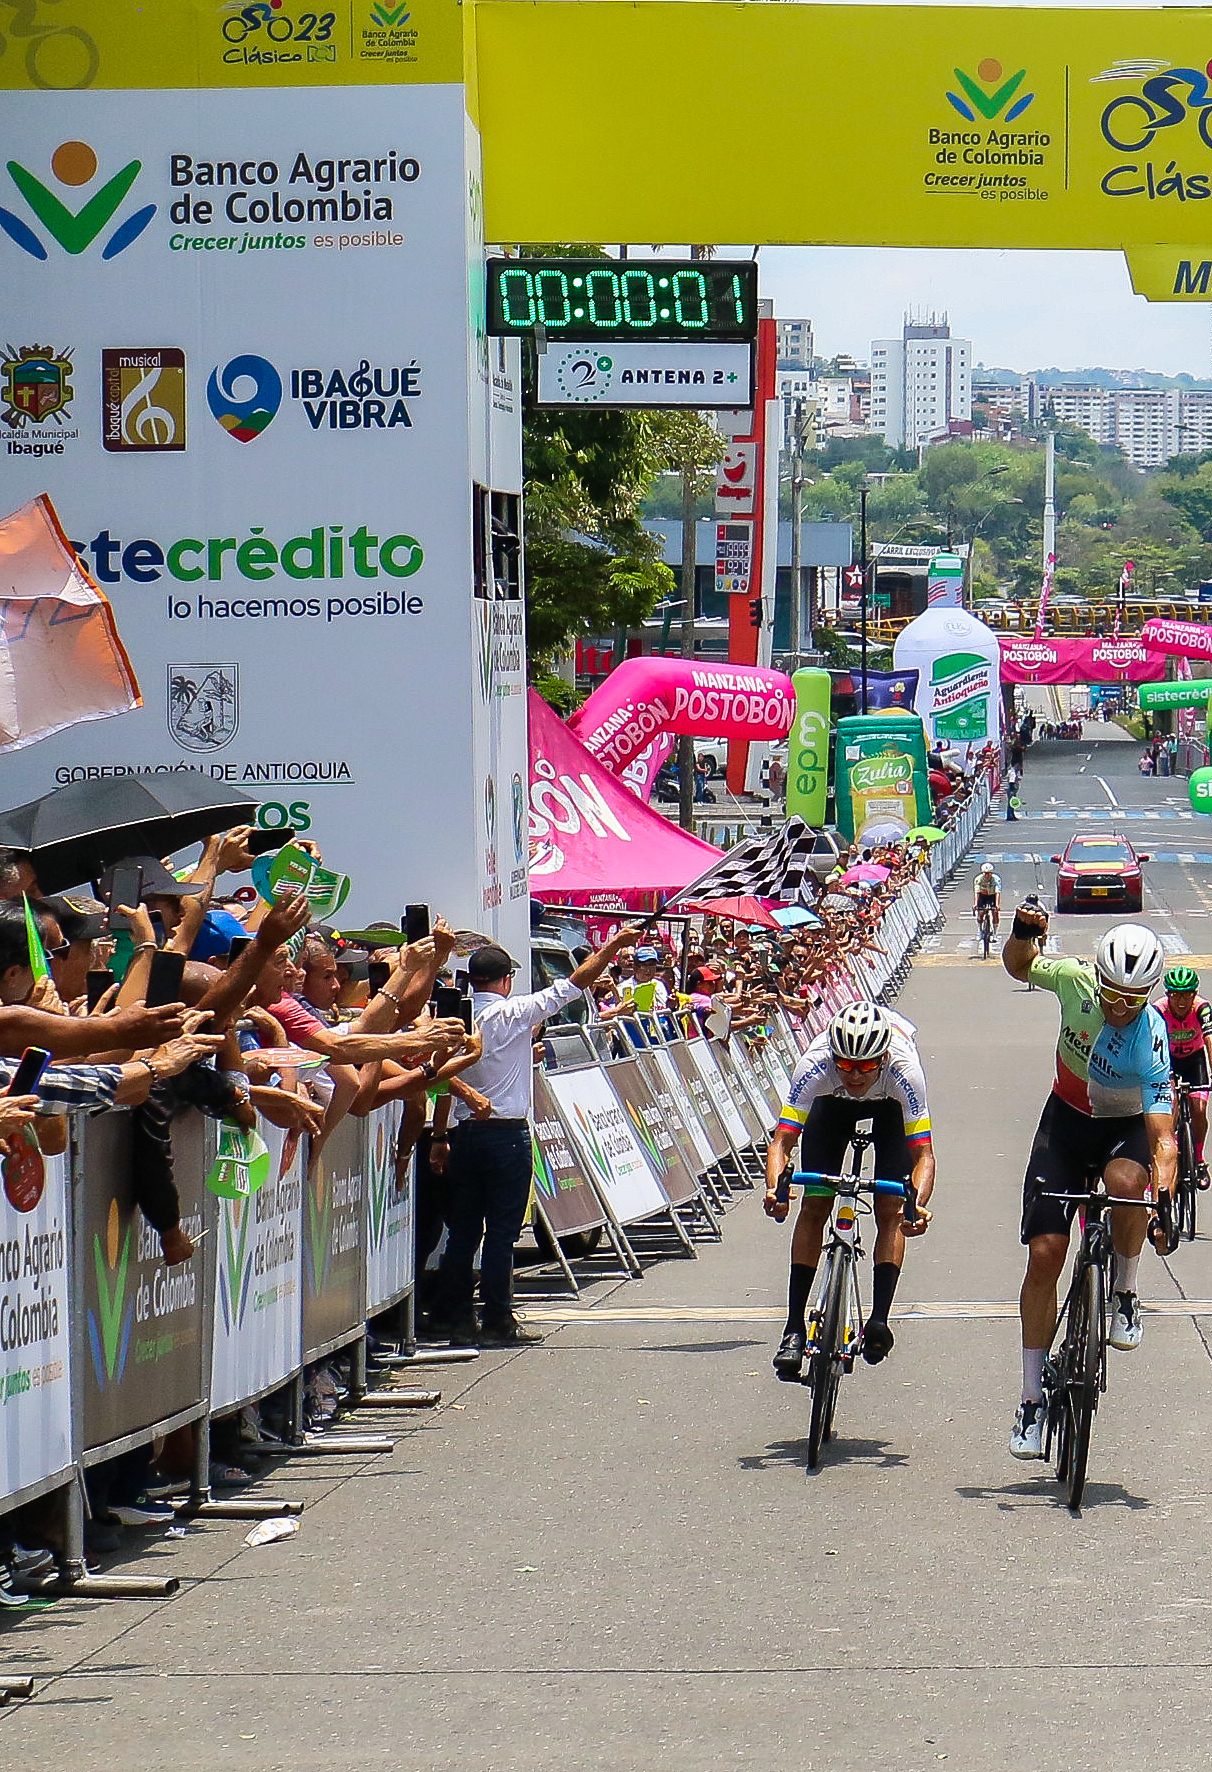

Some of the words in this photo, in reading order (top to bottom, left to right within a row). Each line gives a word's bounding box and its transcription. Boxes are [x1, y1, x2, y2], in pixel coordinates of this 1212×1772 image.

[294, 13, 336, 41] 23
[362, 30, 387, 39] Banco
[389, 30, 418, 41] Agrario
[377, 39, 416, 47] Colombia
[222, 46, 303, 65] Clásico
[929, 129, 982, 147] Banco
[987, 128, 1051, 152] Agrario
[935, 147, 961, 165] de
[963, 146, 1045, 165] Colombia
[170, 154, 279, 187] Banco
[289, 151, 421, 192] Agrario
[923, 173, 974, 188] Crecer
[973, 171, 1027, 191] juntos
[980, 190, 997, 201] es
[999, 187, 1049, 202] posible
[169, 193, 213, 225] de
[226, 190, 393, 224] Colombia
[169, 232, 240, 251] Crecer
[238, 231, 306, 255] juntos
[313, 234, 334, 249] es
[337, 230, 404, 252] posible
[500, 269, 743, 328] 00:00:01
[119, 353, 162, 367] musical
[621, 369, 705, 385] ANTENA
[304, 400, 413, 430] VIBRA
[0, 429, 30, 439] lcaldía
[31, 429, 79, 440] Municipal
[7, 440, 65, 457] Ibagué
[72, 526, 425, 583] stecrédito
[882, 546, 904, 555] CARRIL
[168, 595, 191, 619] lo
[199, 594, 321, 620] hacemos
[327, 591, 424, 623] posible
[691, 670, 768, 693] MANZANA
[933, 670, 988, 698] Aguardiente
[1146, 688, 1212, 704] sistecrédi
[583, 706, 634, 755] ANZANA
[797, 710, 827, 795] epm
[210, 763, 237, 781] DE
[242, 761, 352, 783] ANTIOQUIA
[857, 762, 907, 785] Zulia
[0, 1240, 20, 1281] nco
[23, 1213, 63, 1288] Agrario
[136, 1283, 149, 1323] de
[153, 1264, 196, 1317] Colombia
[0, 1284, 58, 1352] Colombia
